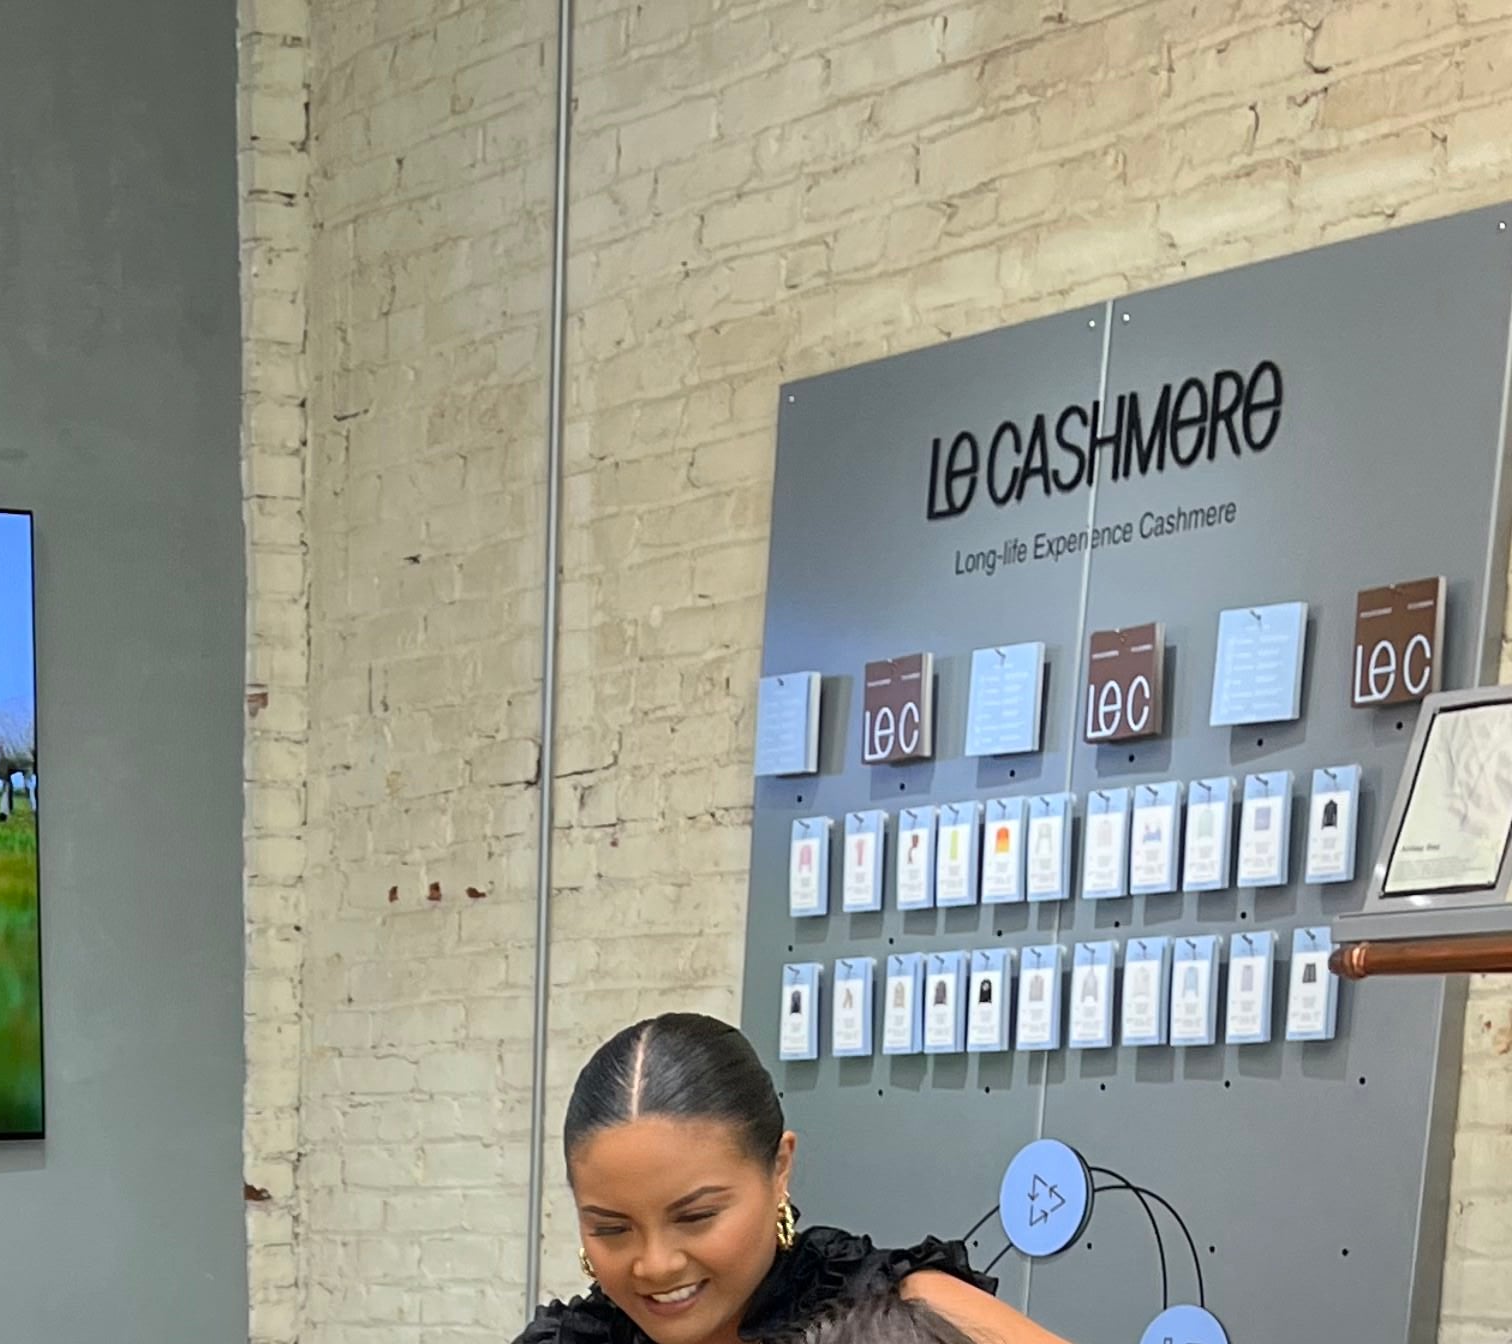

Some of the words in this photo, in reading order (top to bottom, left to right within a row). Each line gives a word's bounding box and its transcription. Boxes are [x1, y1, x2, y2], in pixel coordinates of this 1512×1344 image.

[954, 536, 1028, 576] Long-life
[1033, 521, 1134, 563] Experience
[1139, 501, 1238, 540] Cashmere
